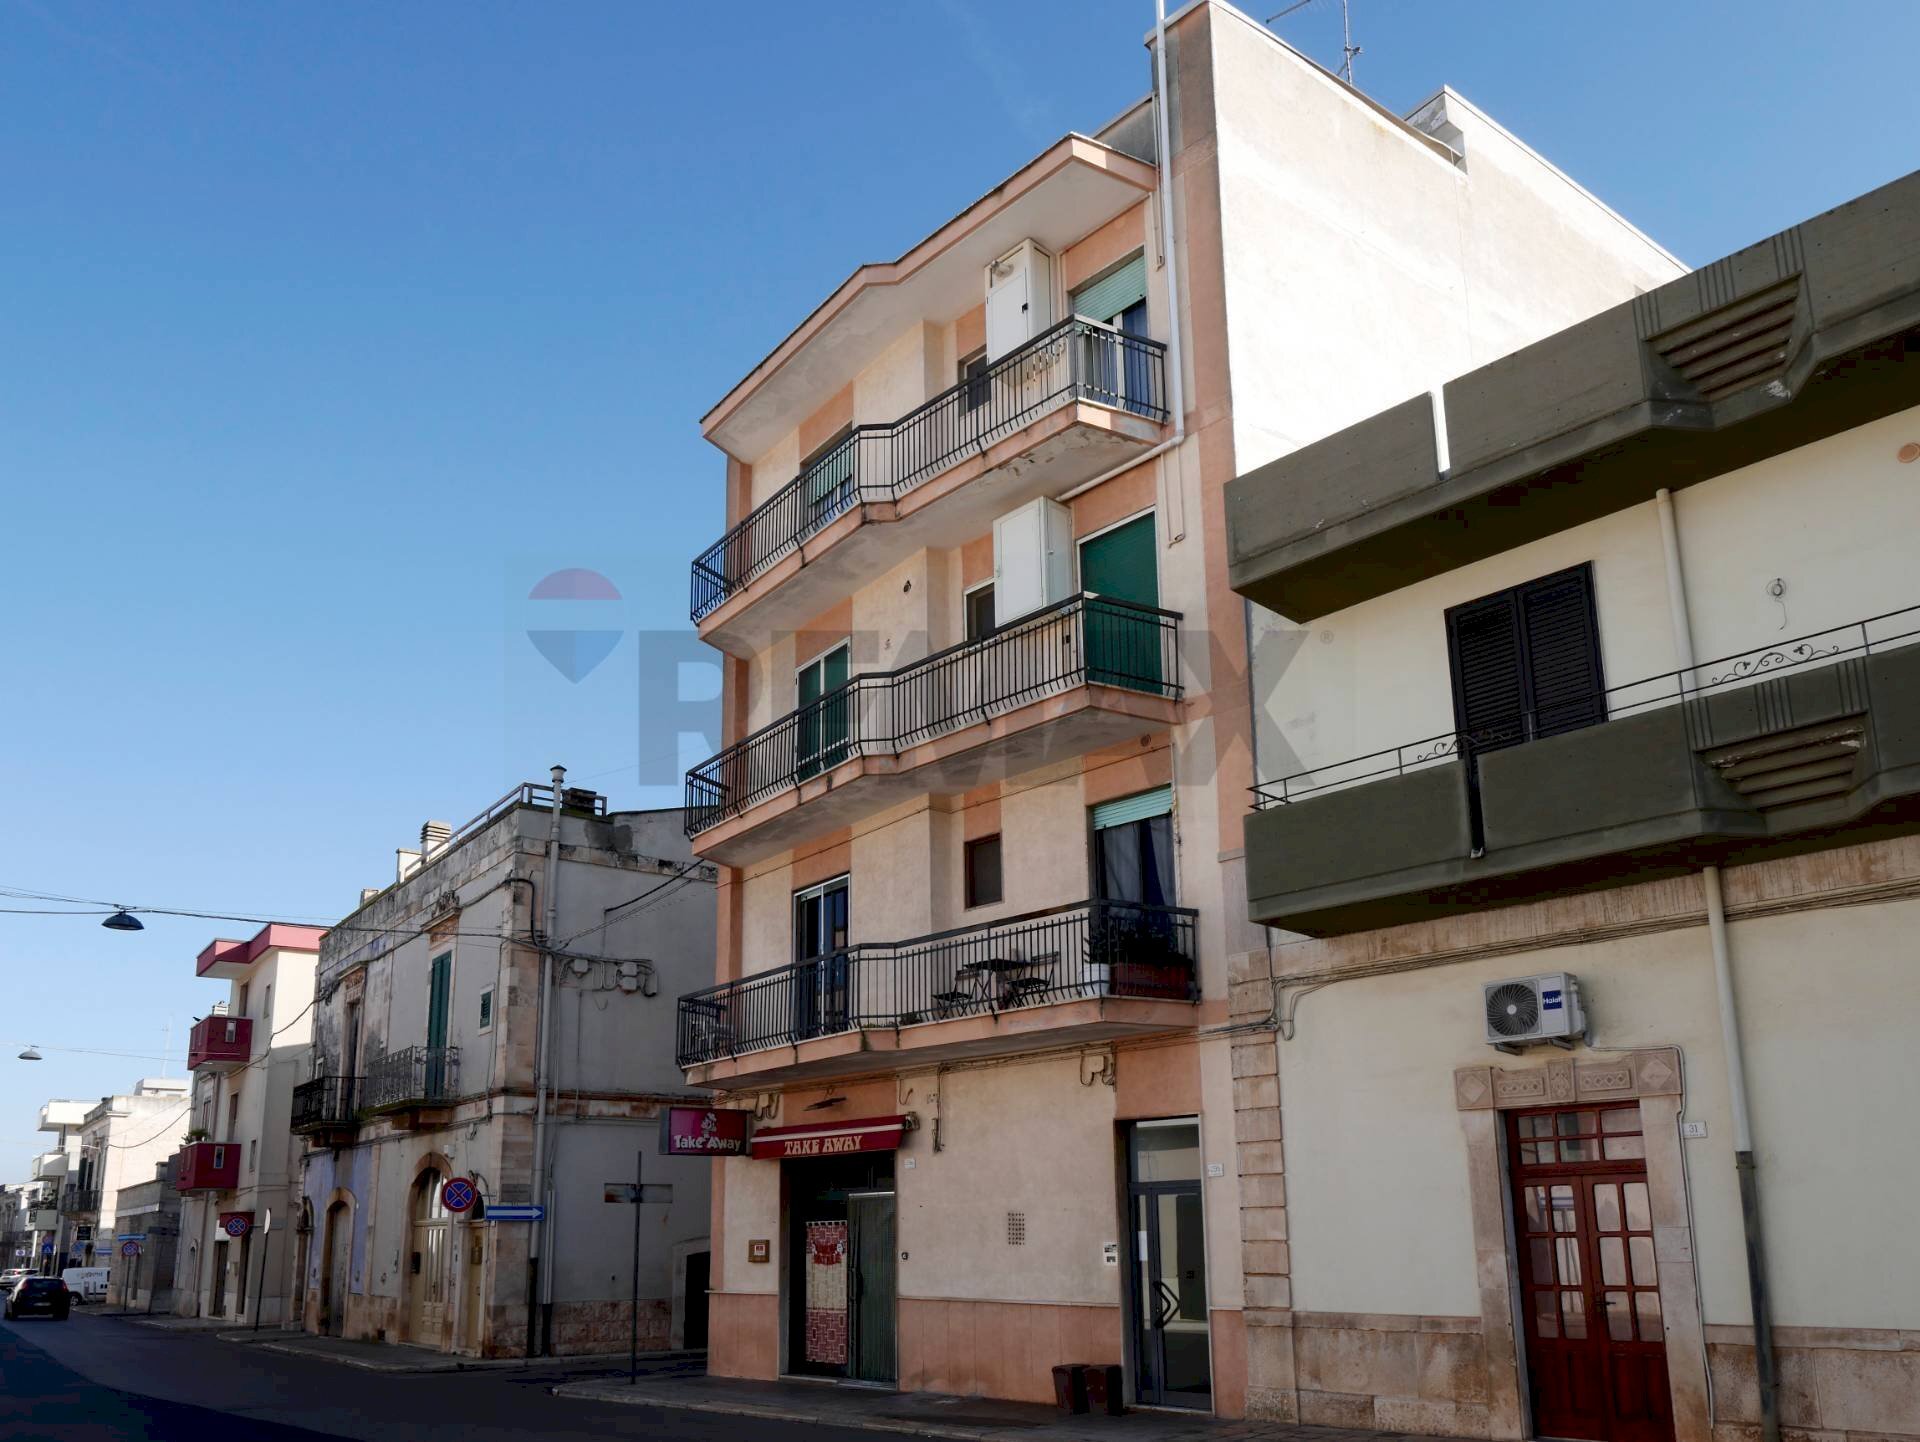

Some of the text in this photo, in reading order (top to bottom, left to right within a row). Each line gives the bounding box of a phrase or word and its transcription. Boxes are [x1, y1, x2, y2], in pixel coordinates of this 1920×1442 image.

[674, 1135, 741, 1152] Take Away
[784, 1135, 863, 1155] TAKE AWAY
